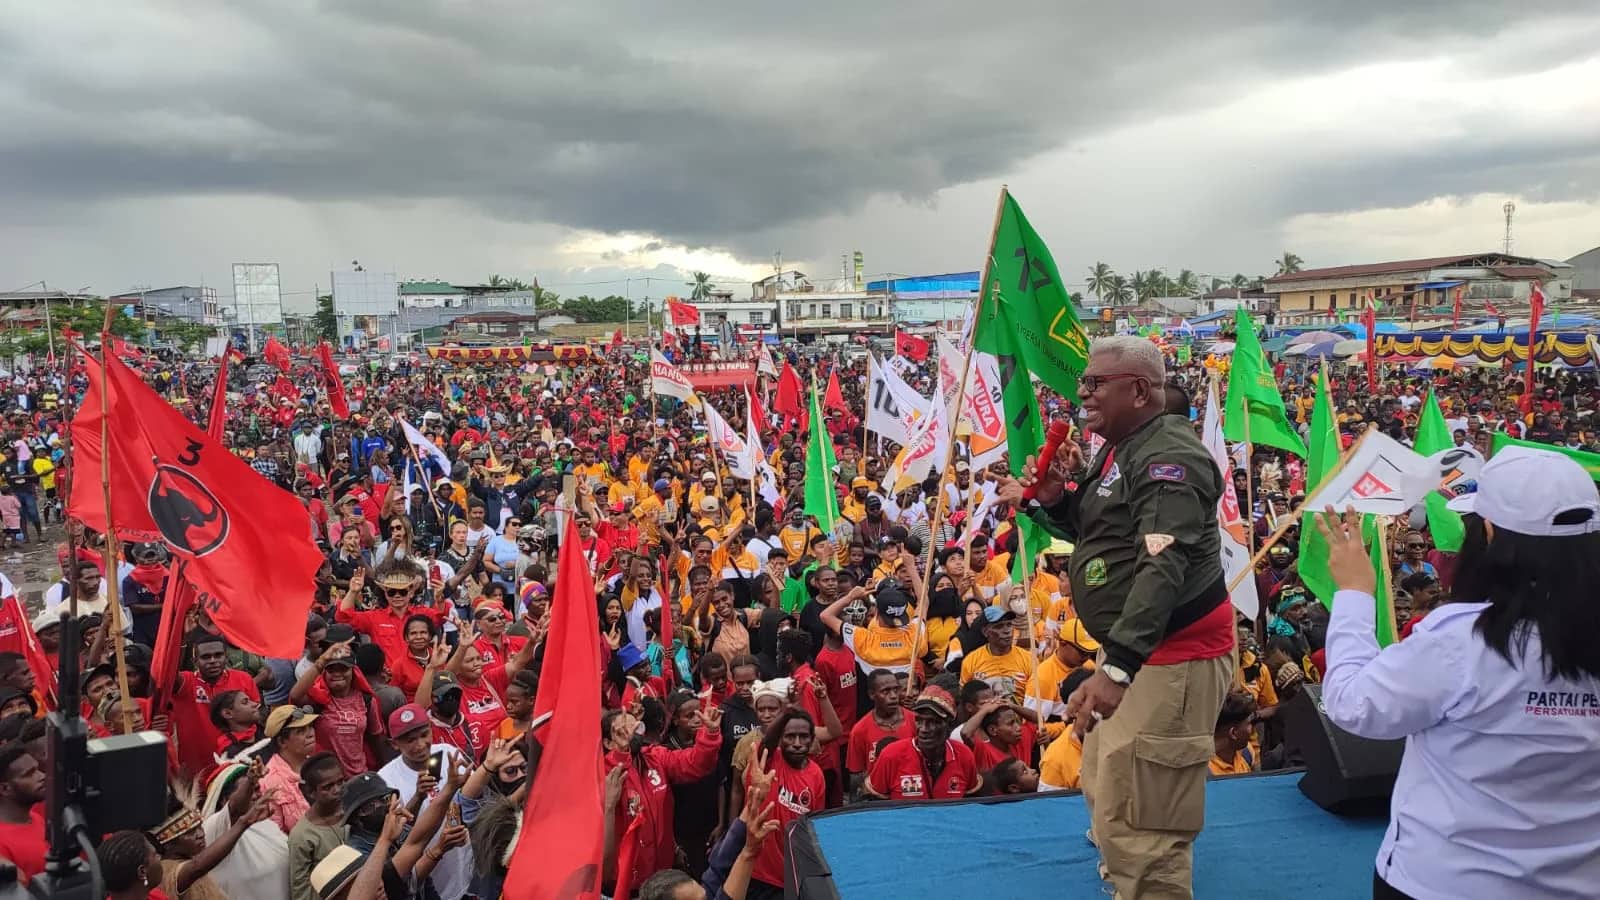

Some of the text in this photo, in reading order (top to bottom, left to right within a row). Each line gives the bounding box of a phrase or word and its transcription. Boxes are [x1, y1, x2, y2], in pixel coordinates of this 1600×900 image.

[654, 363, 690, 386] HANU
[974, 374, 994, 429] NURA
[989, 385, 1003, 404] 10
[177, 435, 205, 467] 3
[1527, 691, 1600, 708] PARTAI PE
[1525, 706, 1586, 717] PERSATUAN
[647, 768, 661, 786] 3
